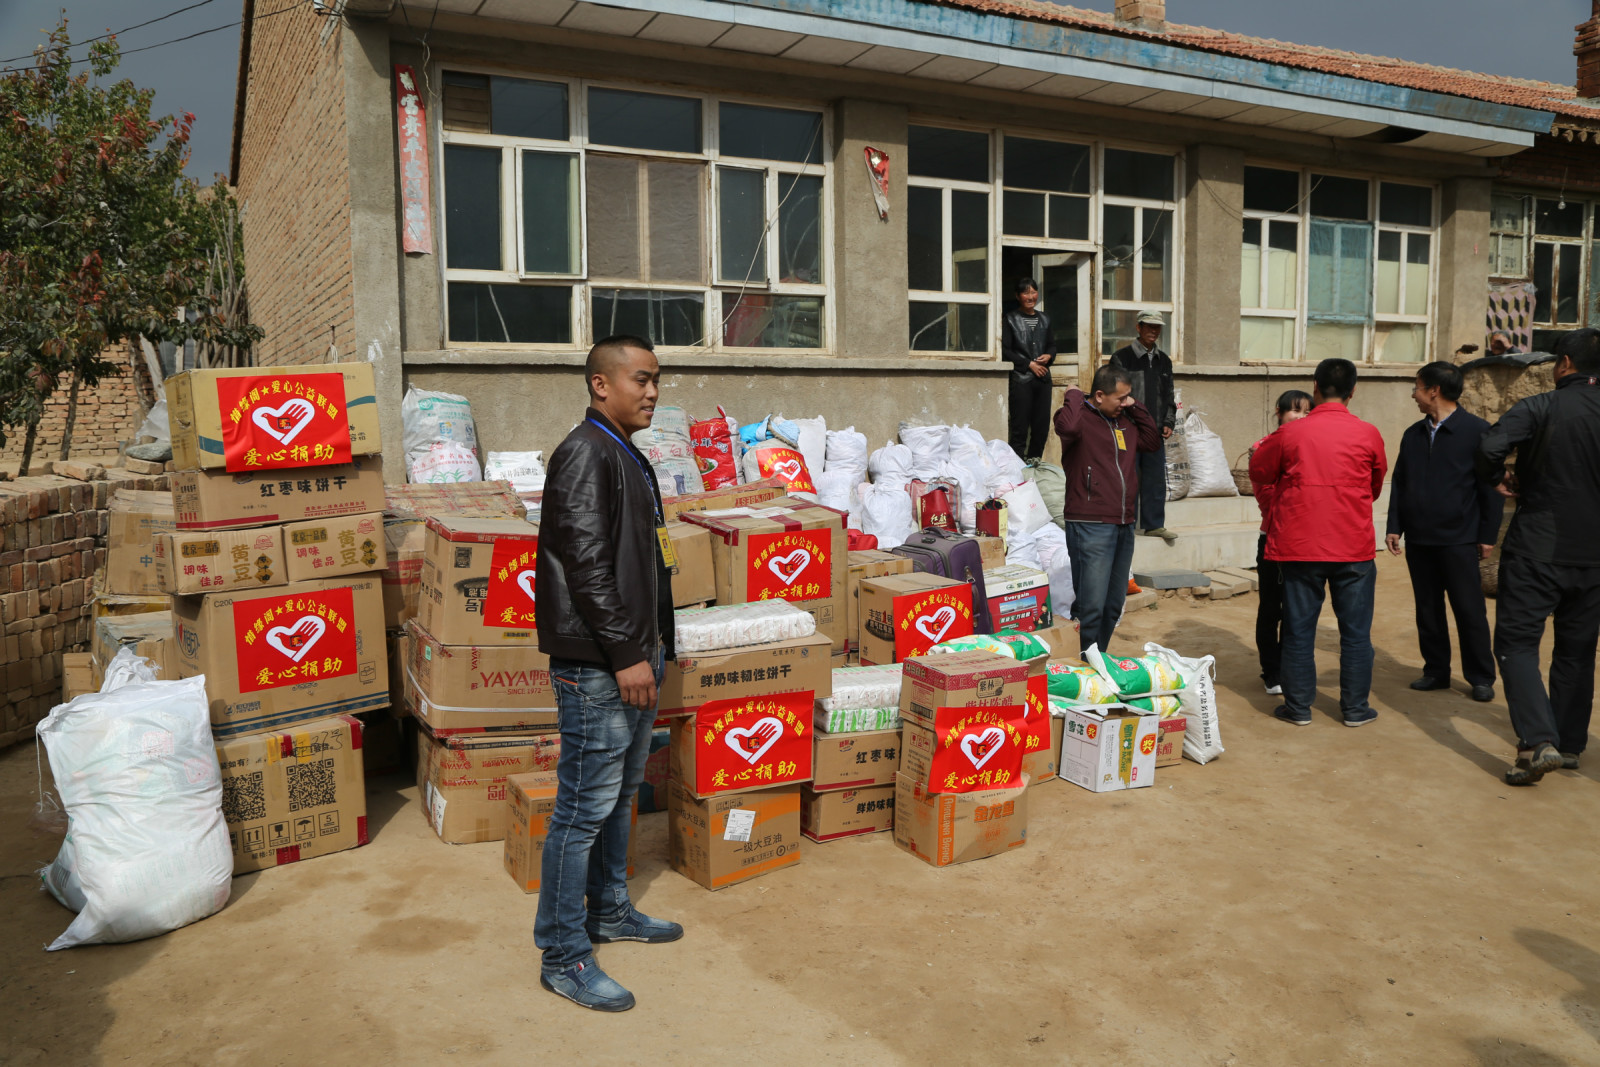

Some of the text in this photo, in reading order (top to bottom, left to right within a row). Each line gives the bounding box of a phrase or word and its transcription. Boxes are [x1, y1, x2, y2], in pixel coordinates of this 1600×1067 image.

[243, 443, 335, 466] 爱心捐助
[260, 476, 347, 497] 红枣味饼干
[296, 546, 320, 558] 调味
[312, 556, 335, 569] 佳品
[183, 564, 209, 576] 调味
[200, 575, 224, 587] 佳品
[758, 582, 820, 601] 爱心捐助
[255, 656, 343, 686] 爱心捐助
[701, 664, 792, 688] 鲜奶味韧性饼干
[711, 761, 796, 787] 爱心捐助
[943, 768, 1011, 789] 爱心捐助
[733, 832, 783, 853] 一级大豆油
